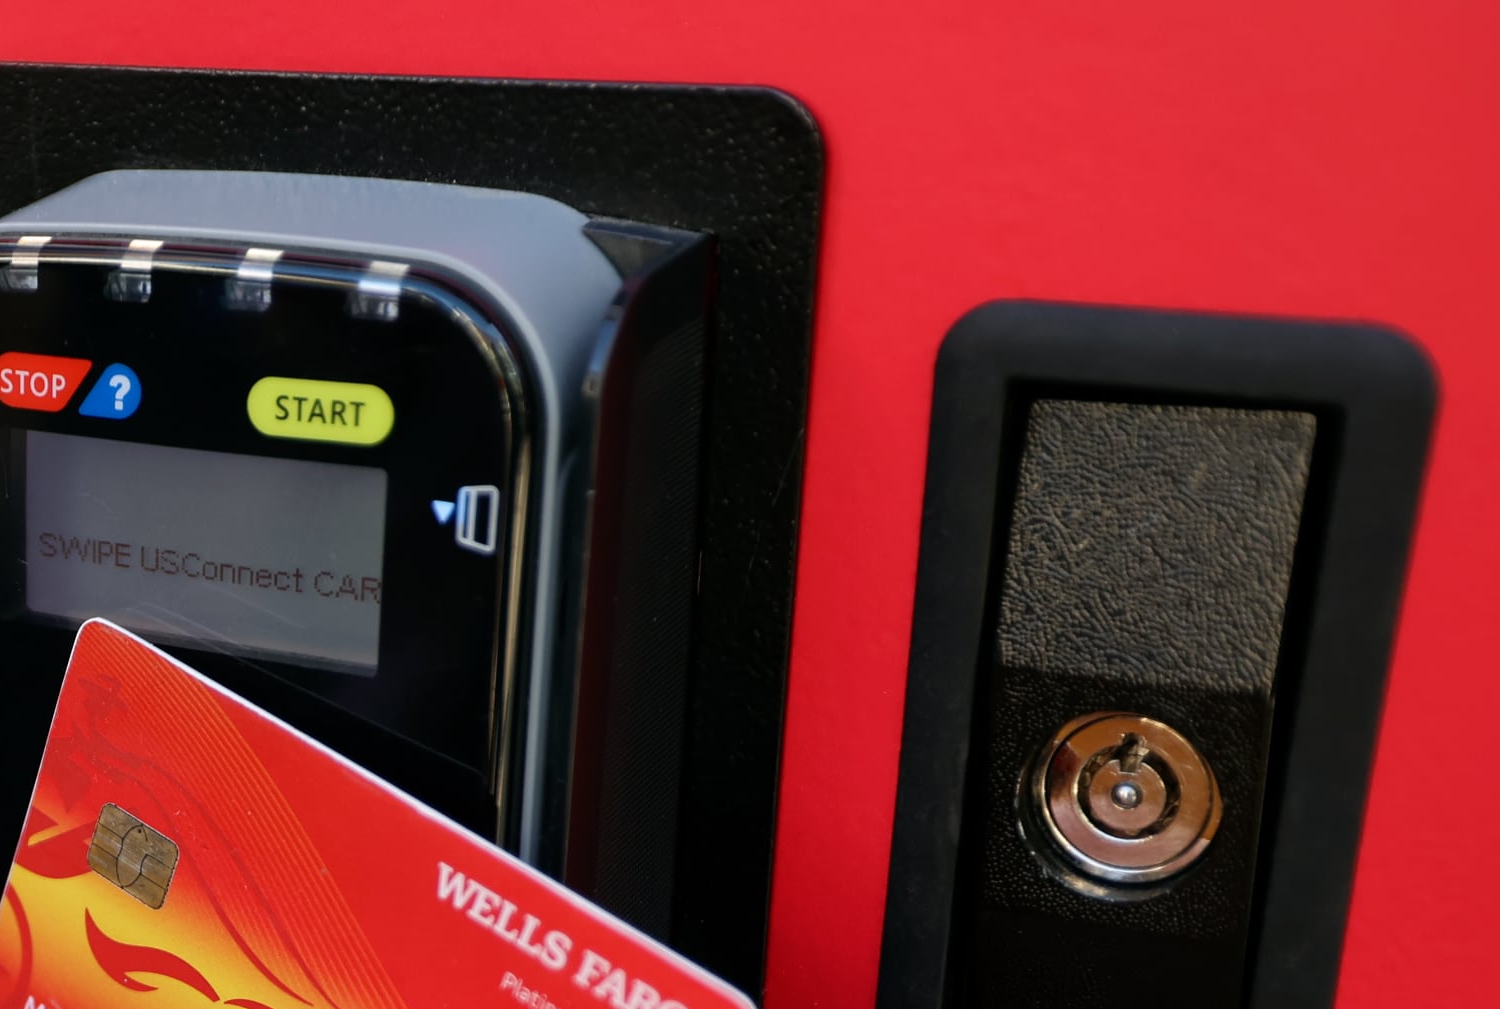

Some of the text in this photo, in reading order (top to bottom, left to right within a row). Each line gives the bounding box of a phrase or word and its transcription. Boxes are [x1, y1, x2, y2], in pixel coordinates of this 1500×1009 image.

[0, 368, 66, 398] STOP
[109, 374, 132, 411] ?
[275, 394, 366, 427] START
[39, 531, 382, 604] SWIPE USConnect CAR
[437, 860, 573, 971] WELLS
